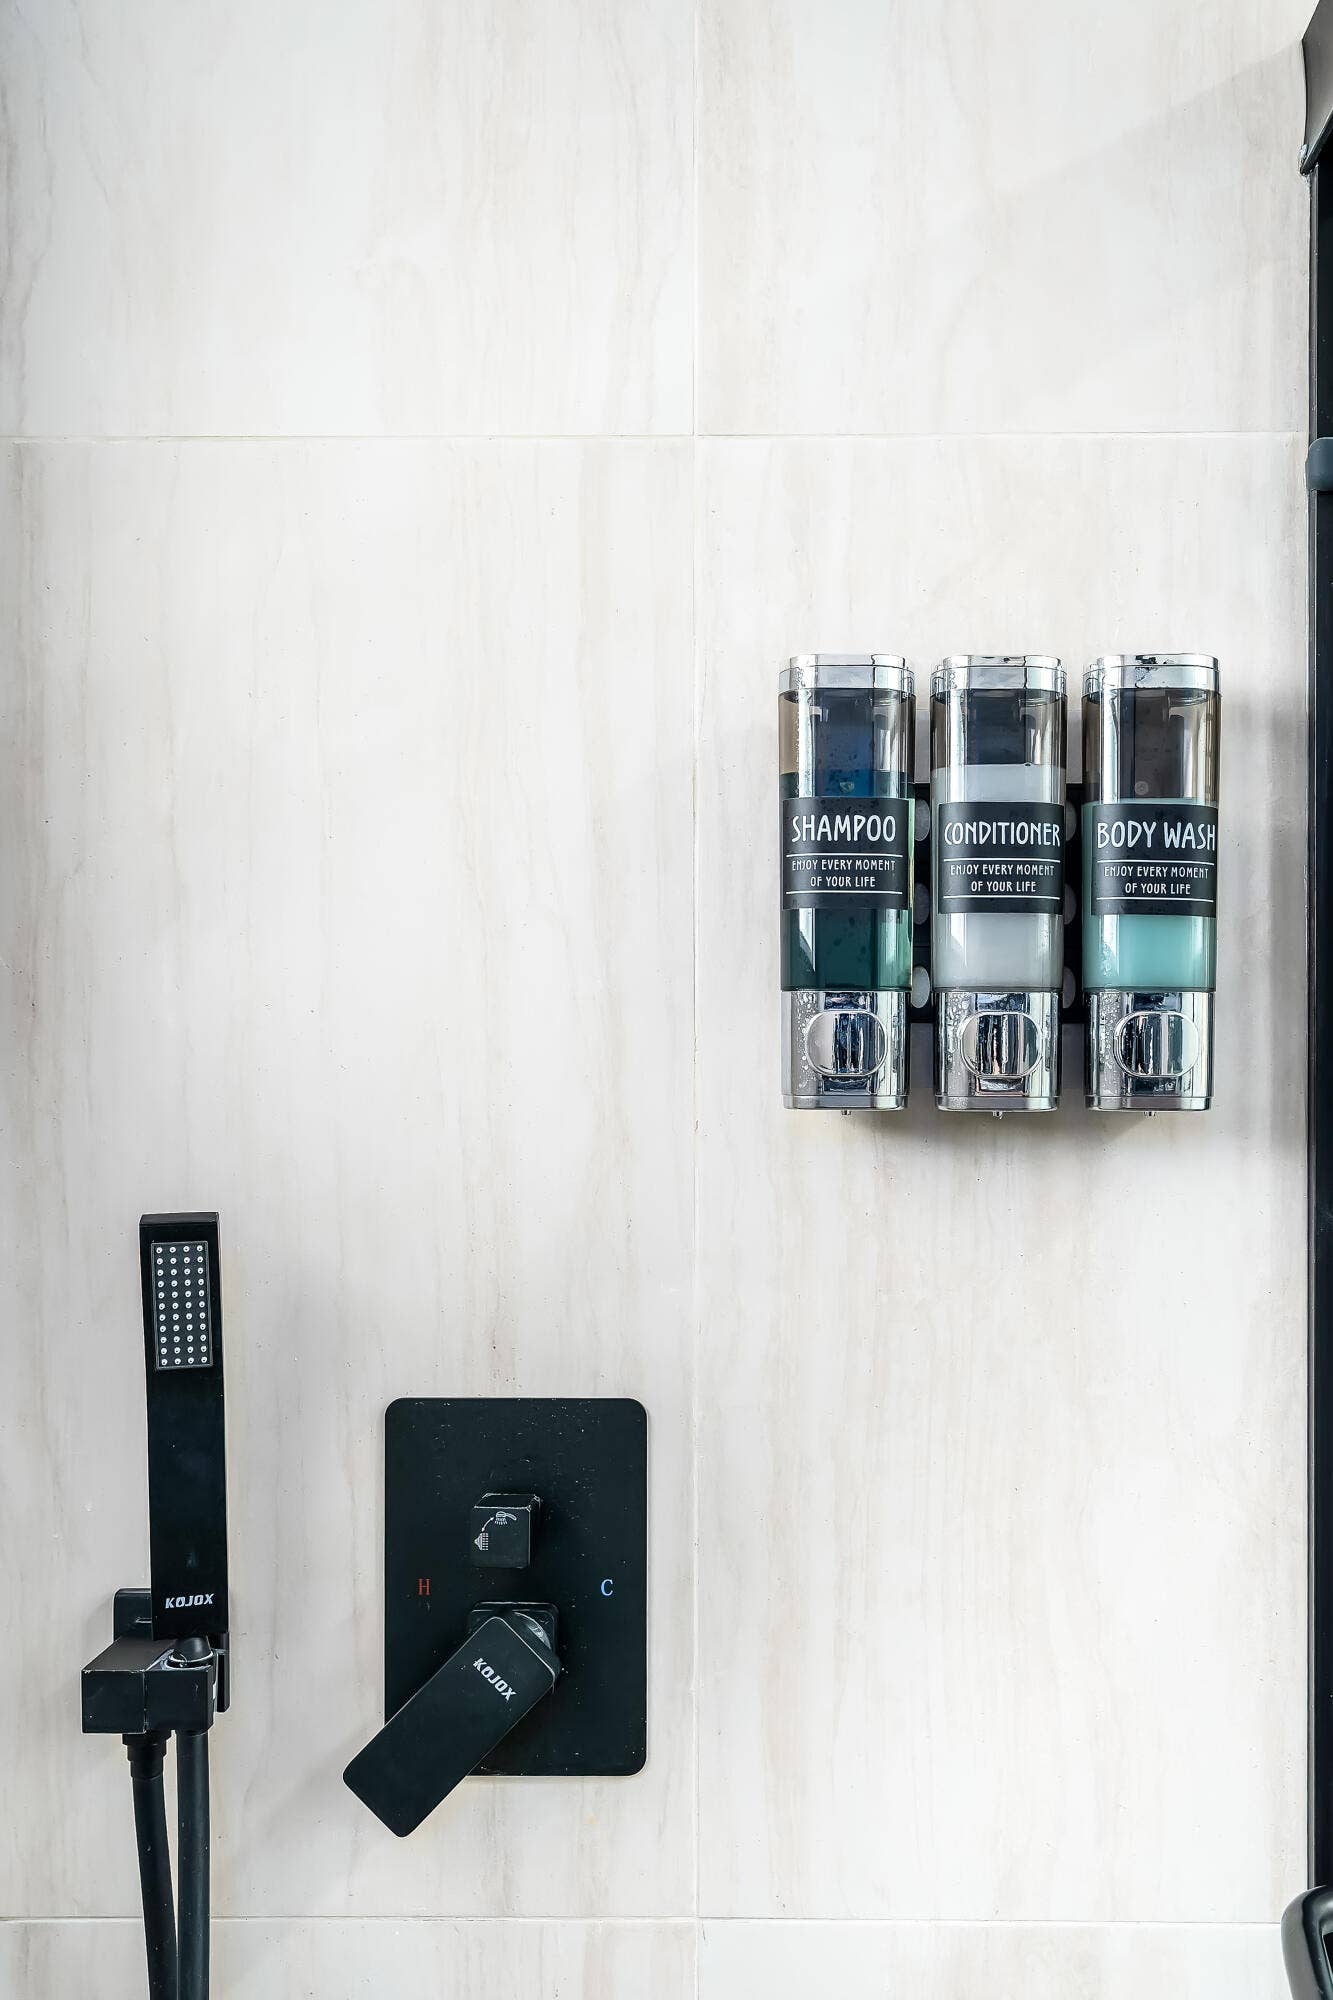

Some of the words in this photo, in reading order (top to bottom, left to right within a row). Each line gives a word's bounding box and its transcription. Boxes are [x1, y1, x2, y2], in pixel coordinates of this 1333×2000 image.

[791, 814, 896, 842] SHAMPOO
[944, 821, 1060, 847] CONDITIONER
[1097, 821, 1157, 849] BODY
[1163, 822, 1216, 851] WASH
[792, 860, 818, 871] ENJOY
[822, 860, 853, 871] EVERY
[855, 860, 895, 871] MOMENT
[951, 865, 979, 876] ENJOY
[982, 865, 1013, 875] EVERY
[1016, 865, 1054, 876] MOMENT
[1104, 866, 1133, 878] ENJOY
[1137, 866, 1168, 877] EVERY
[1171, 867, 1208, 879] MOMENT
[810, 876, 822, 887] OF
[826, 876, 852, 887] YOUR
[855, 876, 876, 887] LIFE
[971, 881, 983, 892] OF
[987, 881, 1013, 891] YOUR
[1016, 881, 1036, 892] LIFE
[1125, 883, 1138, 894] OF
[1141, 883, 1167, 894] YOUR
[1170, 884, 1190, 895] LIFE
[418, 1578, 430, 1596] H
[600, 1579, 614, 1596] C
